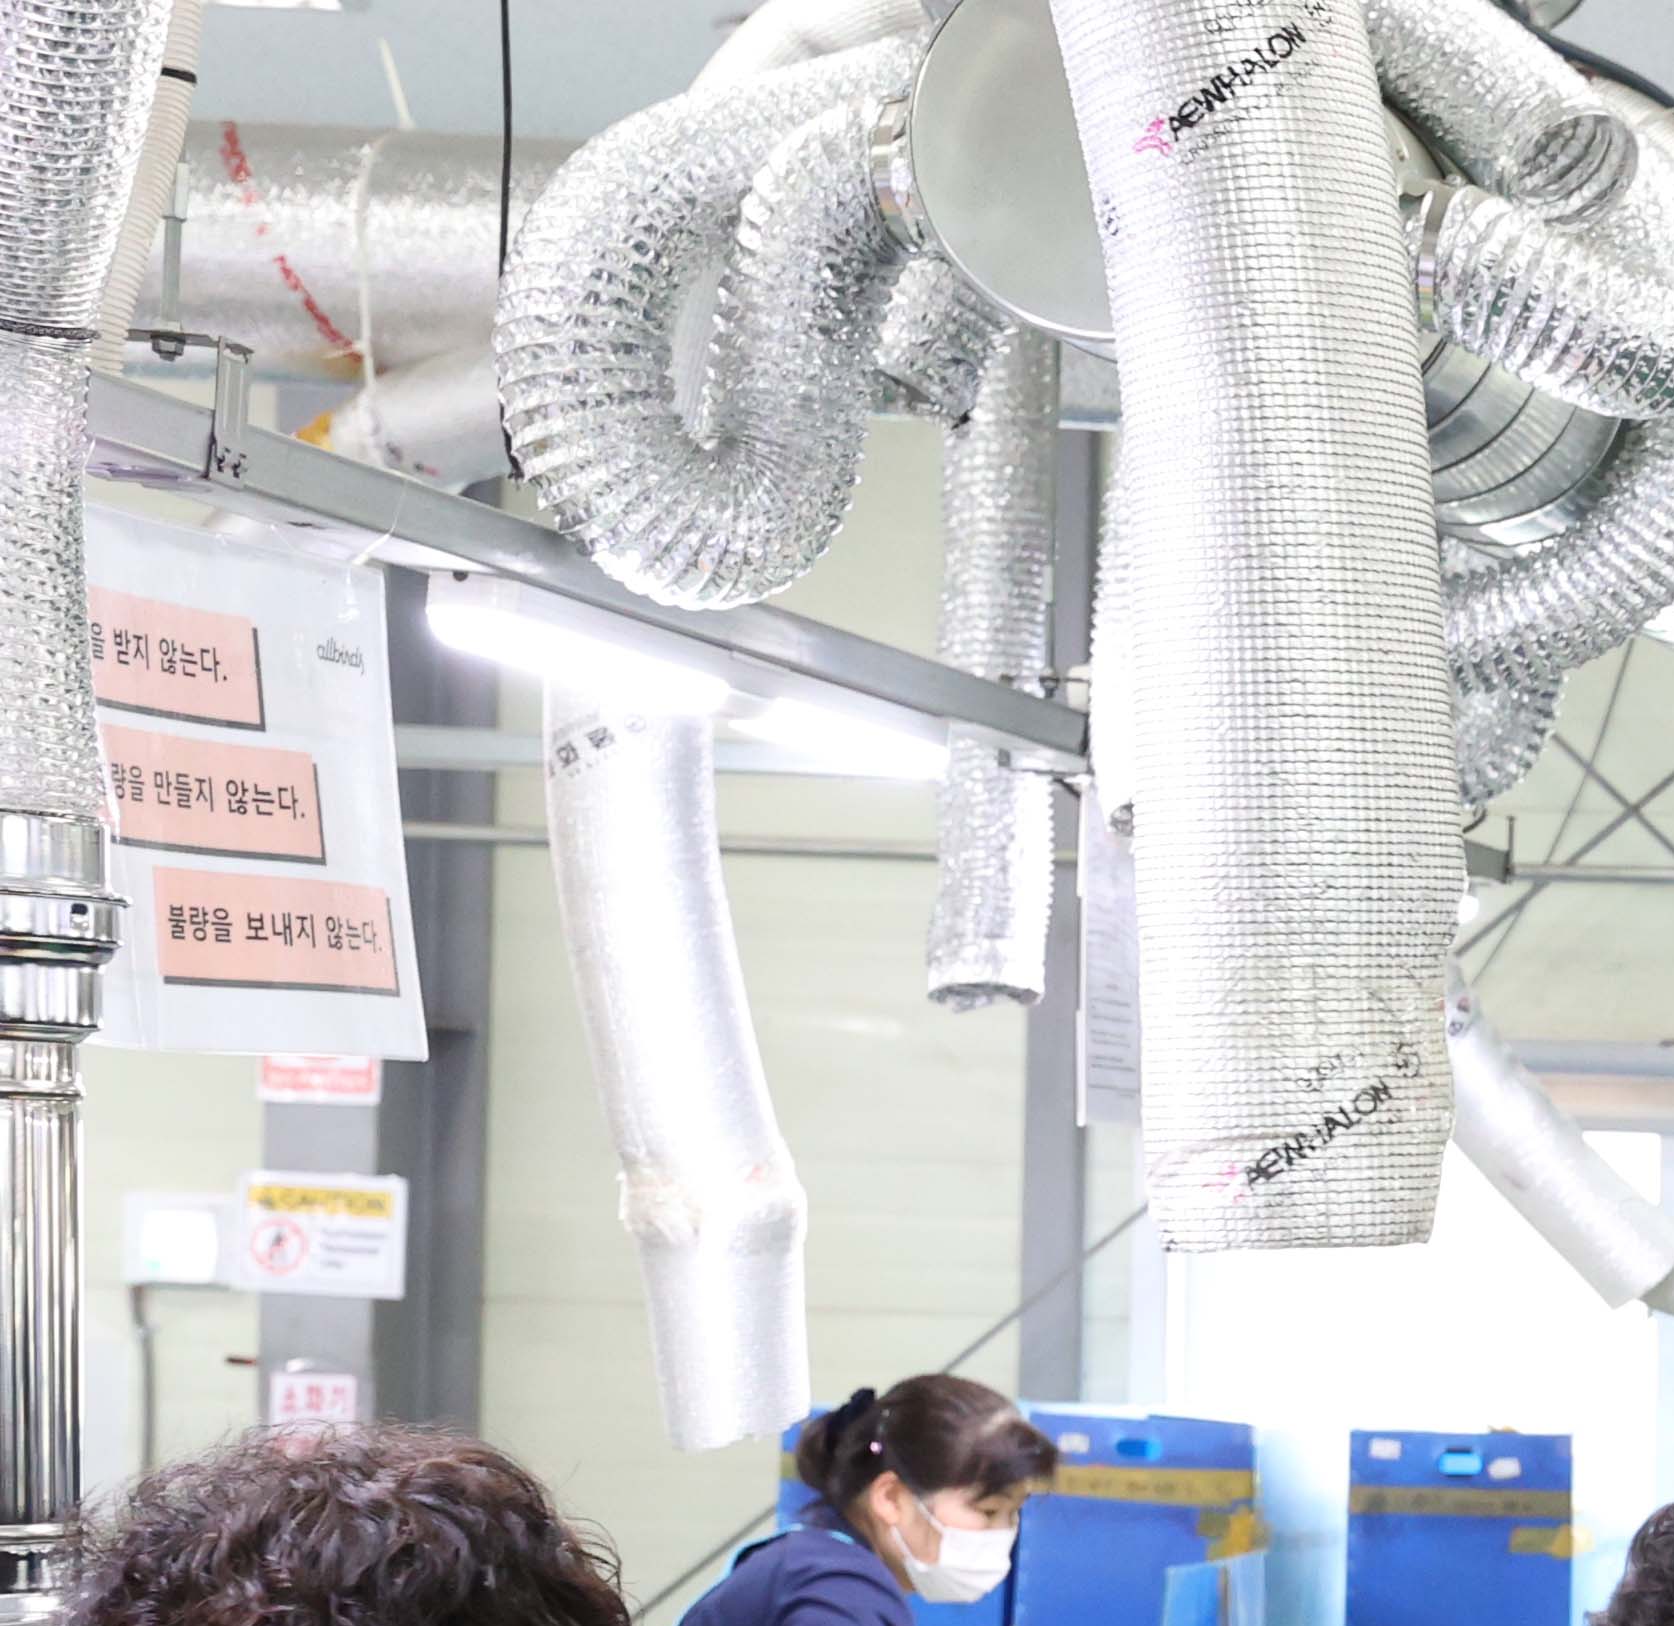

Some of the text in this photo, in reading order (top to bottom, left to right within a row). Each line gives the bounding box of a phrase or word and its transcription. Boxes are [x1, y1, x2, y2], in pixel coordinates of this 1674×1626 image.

[112, 627, 151, 671] 받지
[158, 637, 229, 683] 않는다.
[153, 769, 215, 813] 만들지
[225, 778, 306, 821] 않는다.
[168, 903, 384, 953] 불량을 보내지 않는다.
